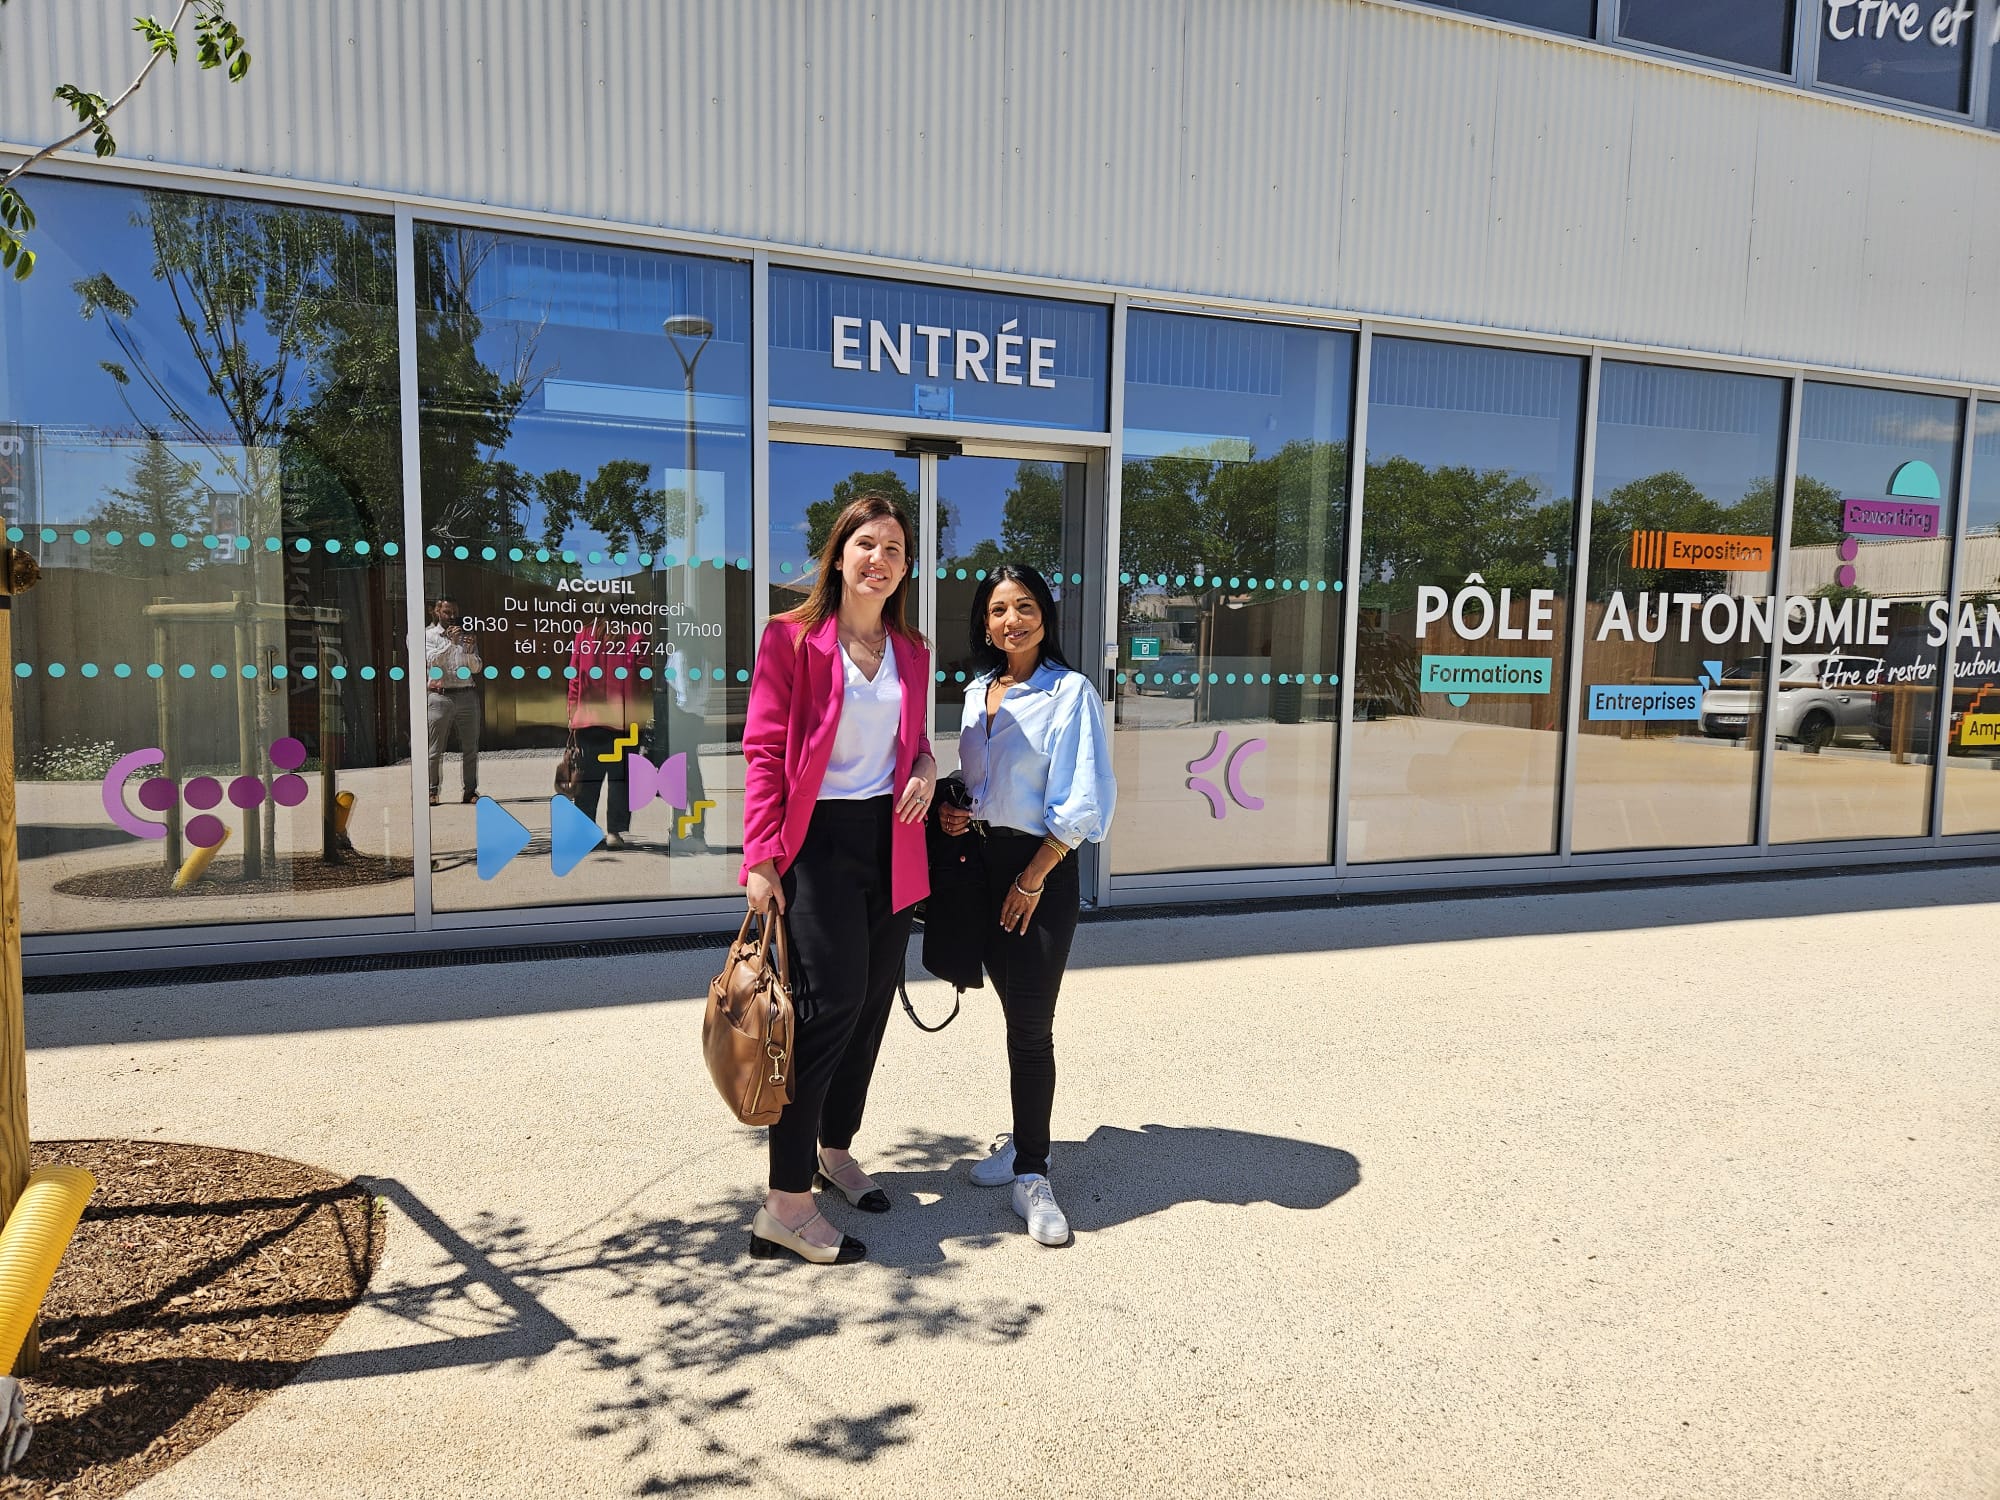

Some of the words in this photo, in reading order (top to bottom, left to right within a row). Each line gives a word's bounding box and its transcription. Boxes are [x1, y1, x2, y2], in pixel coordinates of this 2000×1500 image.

[1930, 0, 1975, 47] et
[832, 315, 1057, 388] ENTRÉE
[1849, 505, 1933, 534] Coworking
[1672, 540, 1763, 564] Exposition
[556, 578, 635, 595] ACCUEIL
[504, 597, 529, 612] Du
[533, 597, 577, 613] lundi
[581, 602, 606, 614] au
[609, 600, 685, 617] vendredi
[1415, 572, 1554, 641] PÔLE
[1597, 591, 1891, 646] AUTONOMIE
[462, 616, 508, 632] 8h30
[533, 617, 584, 634] 12h00
[604, 620, 653, 636] 13h00
[675, 622, 722, 637] 17h00
[553, 639, 676, 656] 04.67.22.47.40
[1429, 664, 1543, 685] Formations
[1821, 646, 1862, 690] Être
[1865, 658, 1886, 684] et
[1887, 655, 1936, 682] rester
[1953, 651, 2000, 678] auton
[1595, 691, 1696, 715] Entreprises
